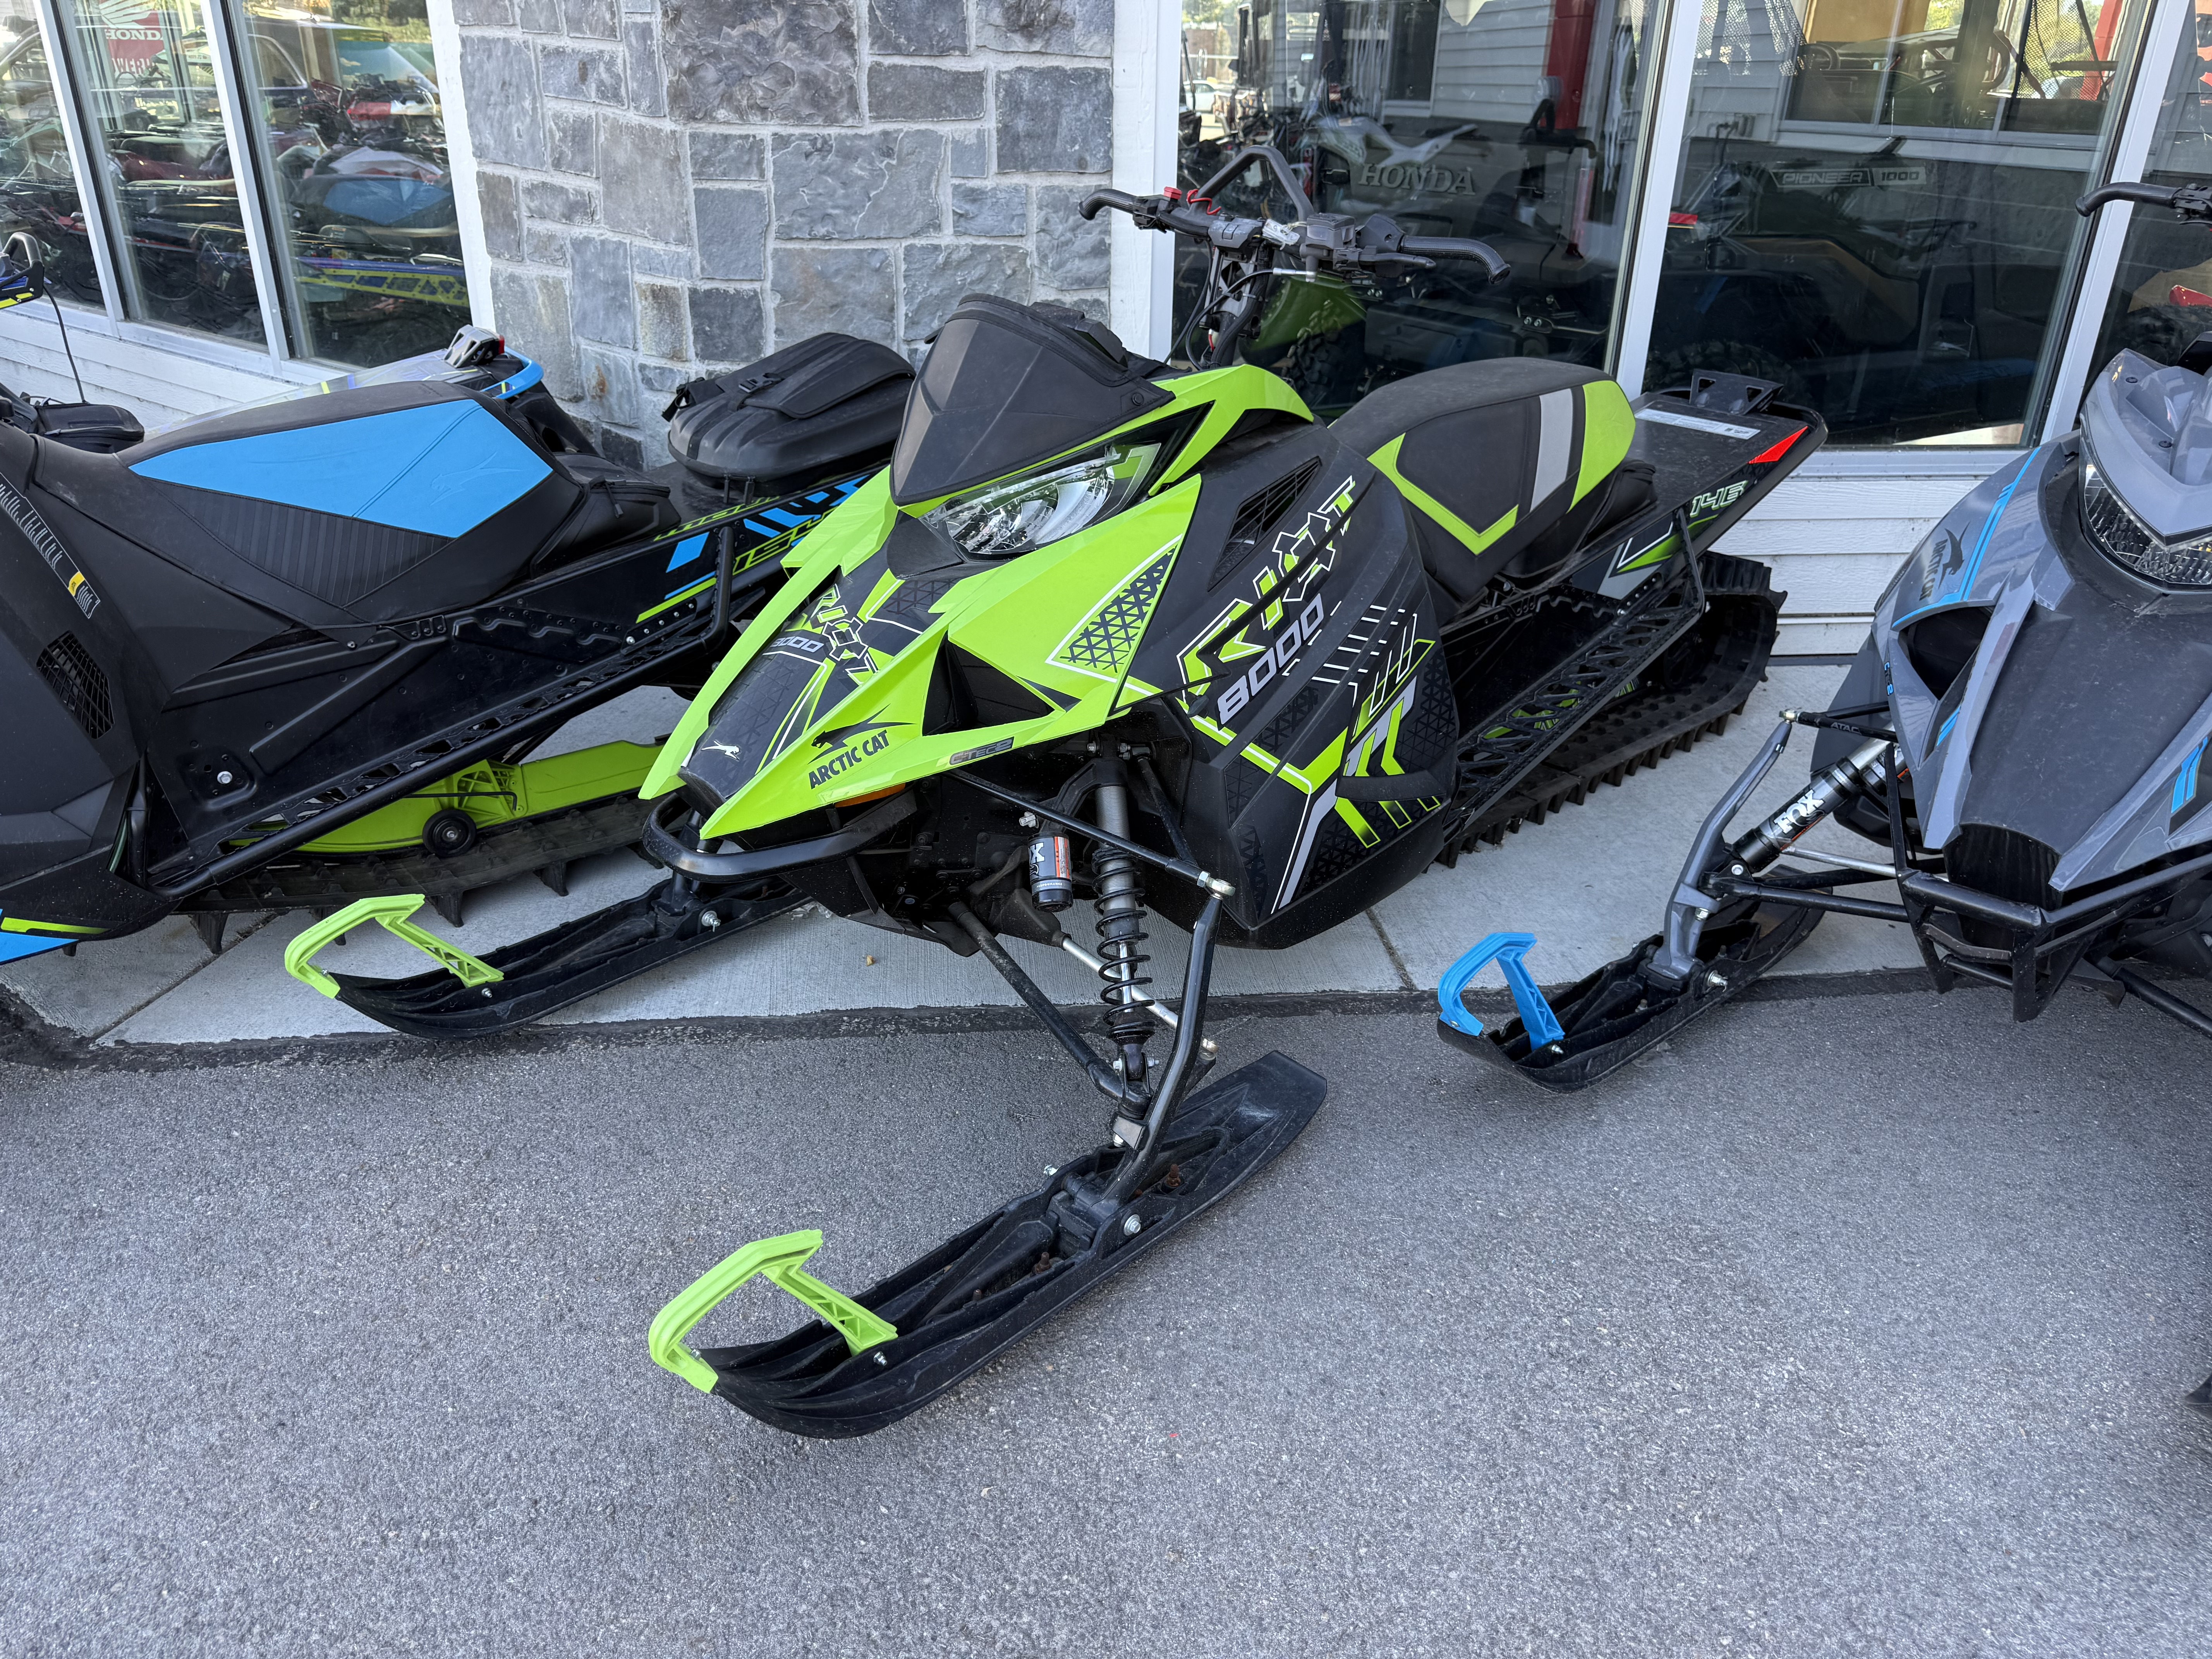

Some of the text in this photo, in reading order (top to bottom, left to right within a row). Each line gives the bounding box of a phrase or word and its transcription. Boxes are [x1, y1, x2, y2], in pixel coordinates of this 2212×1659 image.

[1358, 163, 1475, 195] HONDA
[1782, 171, 1920, 184] PIONEER 1000
[1690, 480, 1748, 518] 146
[1919, 538, 1948, 601] ARCTIC CAT
[1217, 592, 1324, 725] 8000
[808, 729, 890, 790] ARCTIC CAT
[1774, 789, 1824, 834] FOX
